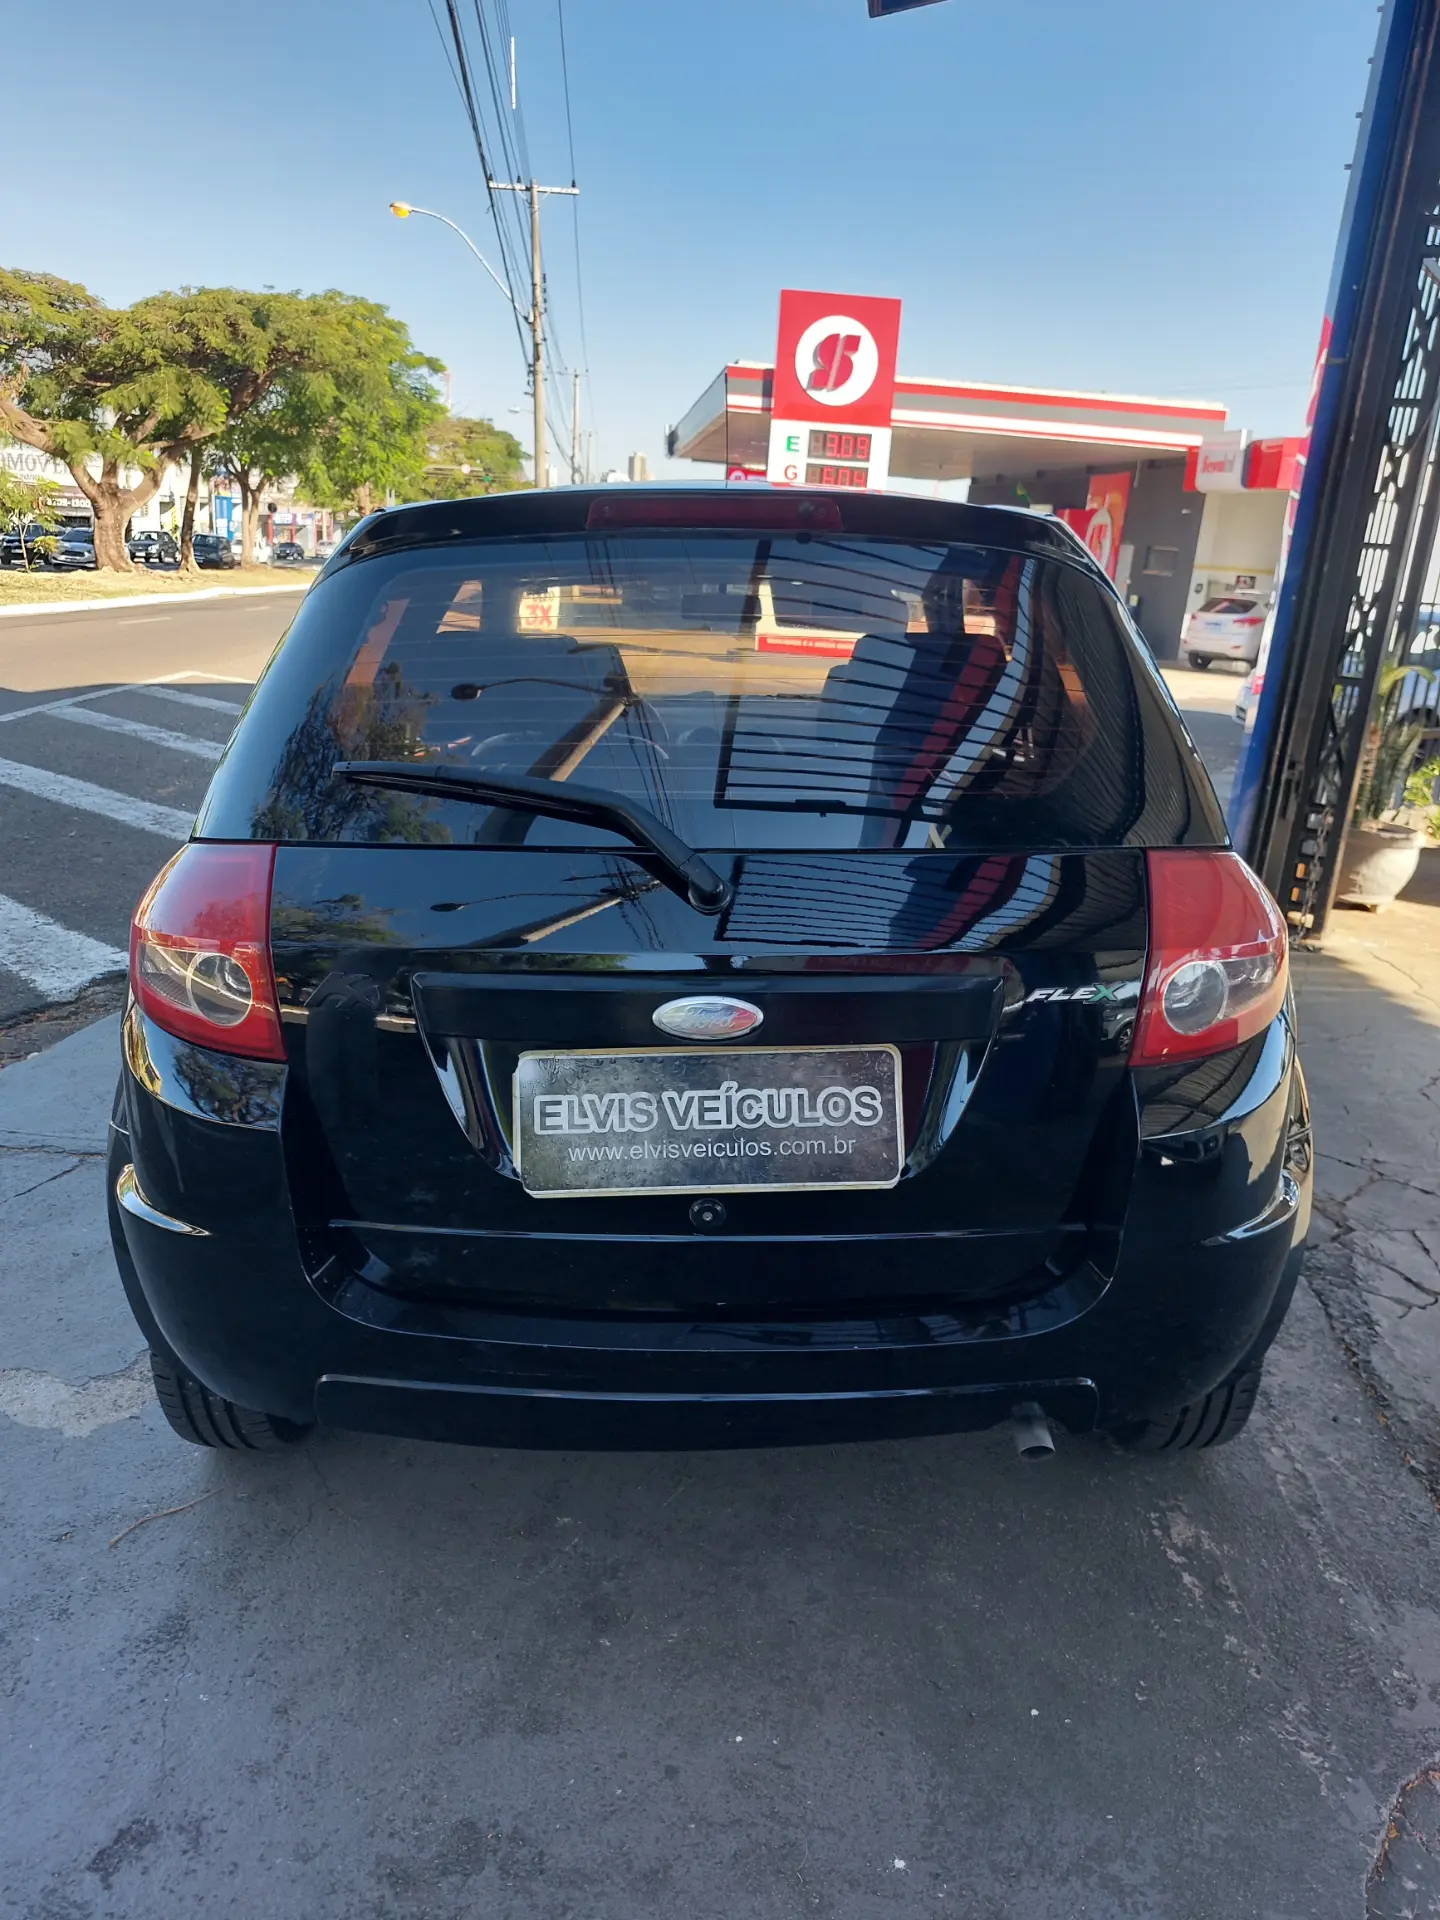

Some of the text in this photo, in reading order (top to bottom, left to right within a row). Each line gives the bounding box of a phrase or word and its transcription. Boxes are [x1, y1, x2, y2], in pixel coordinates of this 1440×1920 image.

[785, 433, 870, 460] E 3.09
[783, 464, 798, 481] G
[1024, 982, 1125, 1004] FLEX
[673, 1003, 743, 1029] Ford
[533, 1080, 884, 1136] ELVIS VEÍCULOS
[568, 1134, 857, 1162] www.elvisveiculos.com.br
